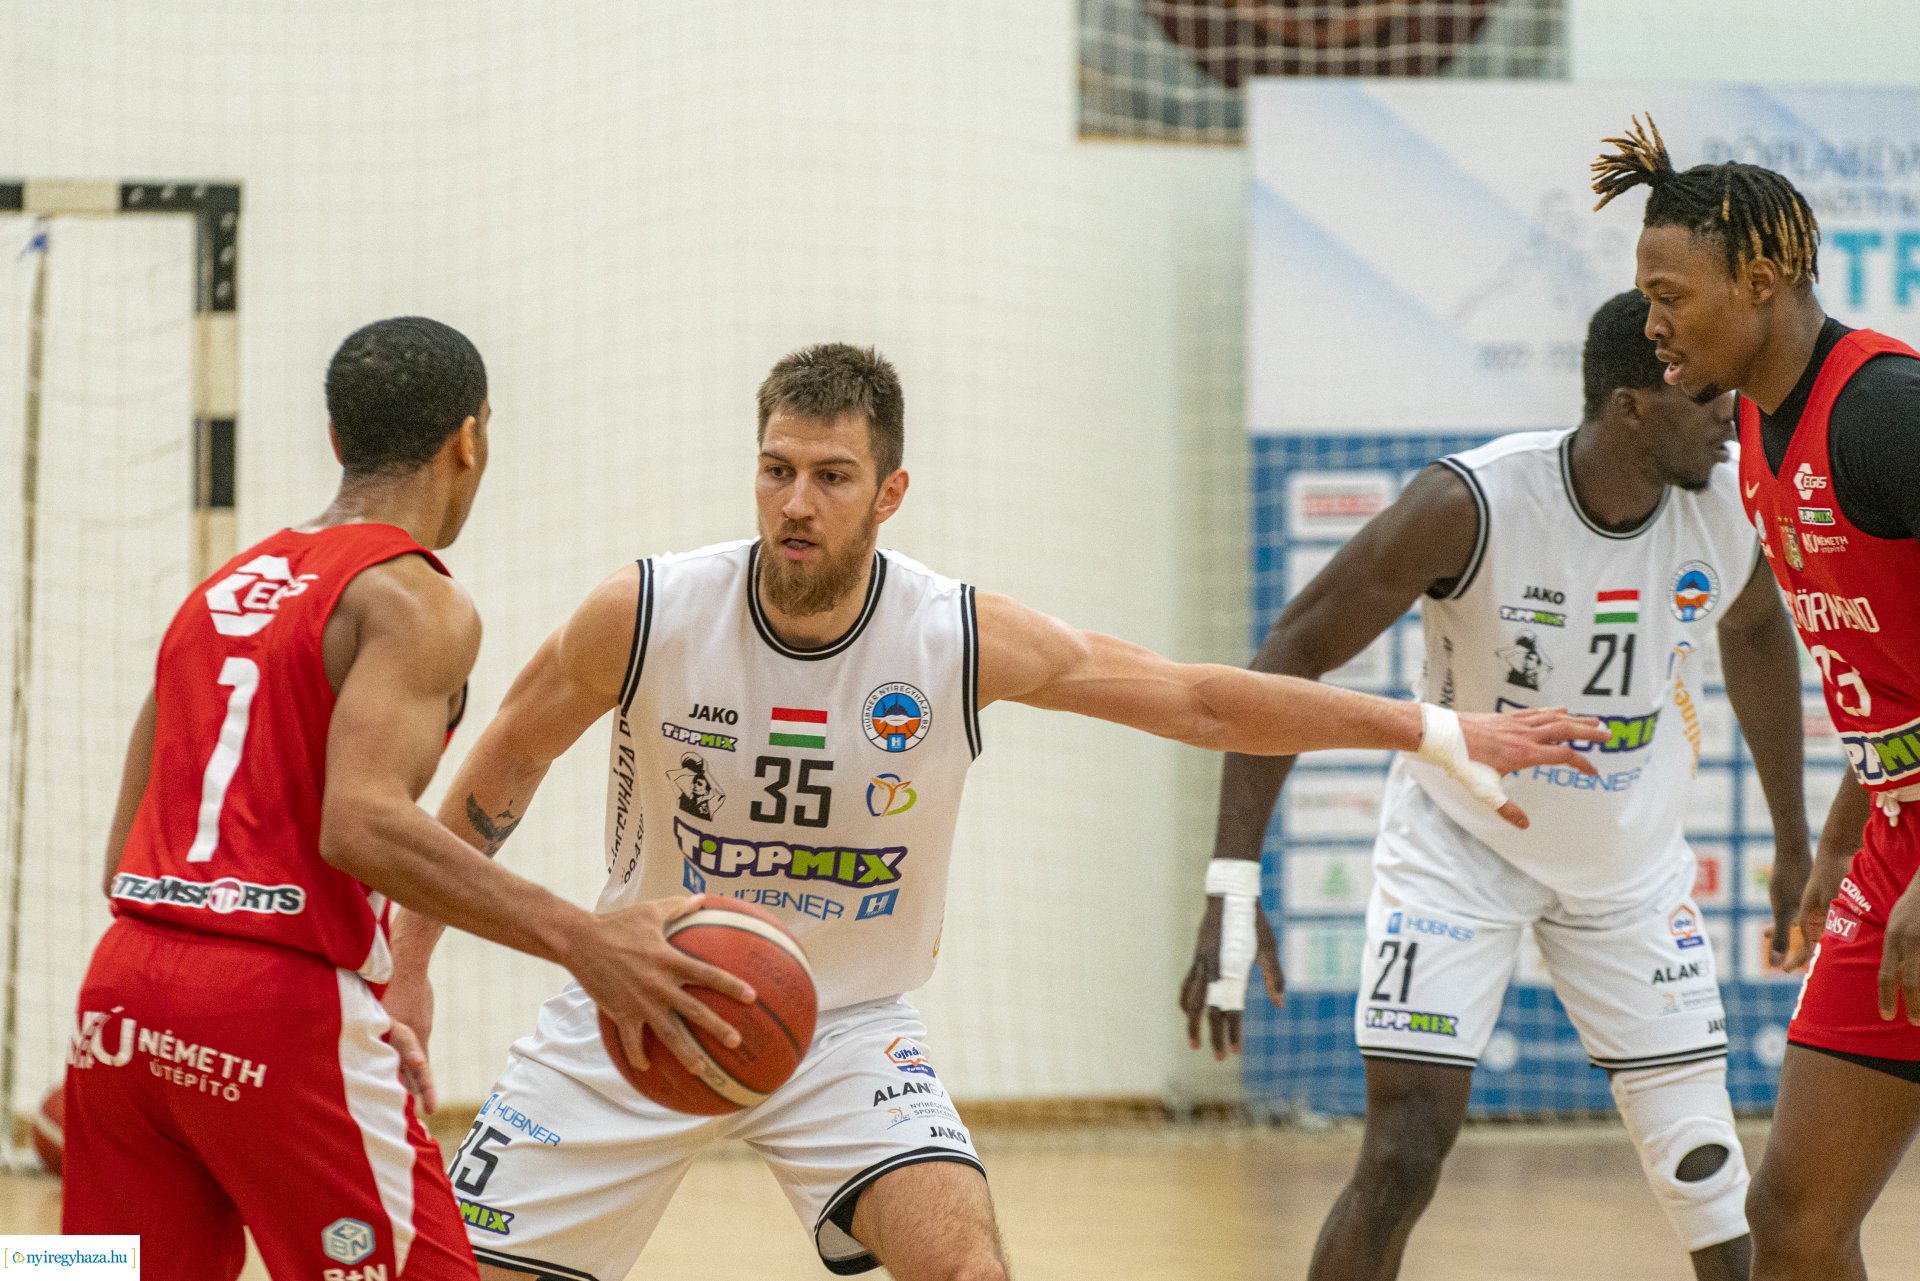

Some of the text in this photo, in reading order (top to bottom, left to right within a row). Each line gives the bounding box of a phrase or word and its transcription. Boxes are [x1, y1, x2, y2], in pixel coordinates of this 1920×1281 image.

[1803, 475, 1828, 489] EGIS
[1523, 585, 1566, 606] JAKO
[1582, 633, 1636, 696] 21
[688, 703, 739, 726] JAKO
[186, 657, 260, 863] 1
[750, 755, 834, 828] 35
[1371, 940, 1418, 1003] 21
[138, 1027, 267, 1088] NÉMETH
[492, 1102, 562, 1147] HÜBNER
[930, 1126, 967, 1144] JAKO
